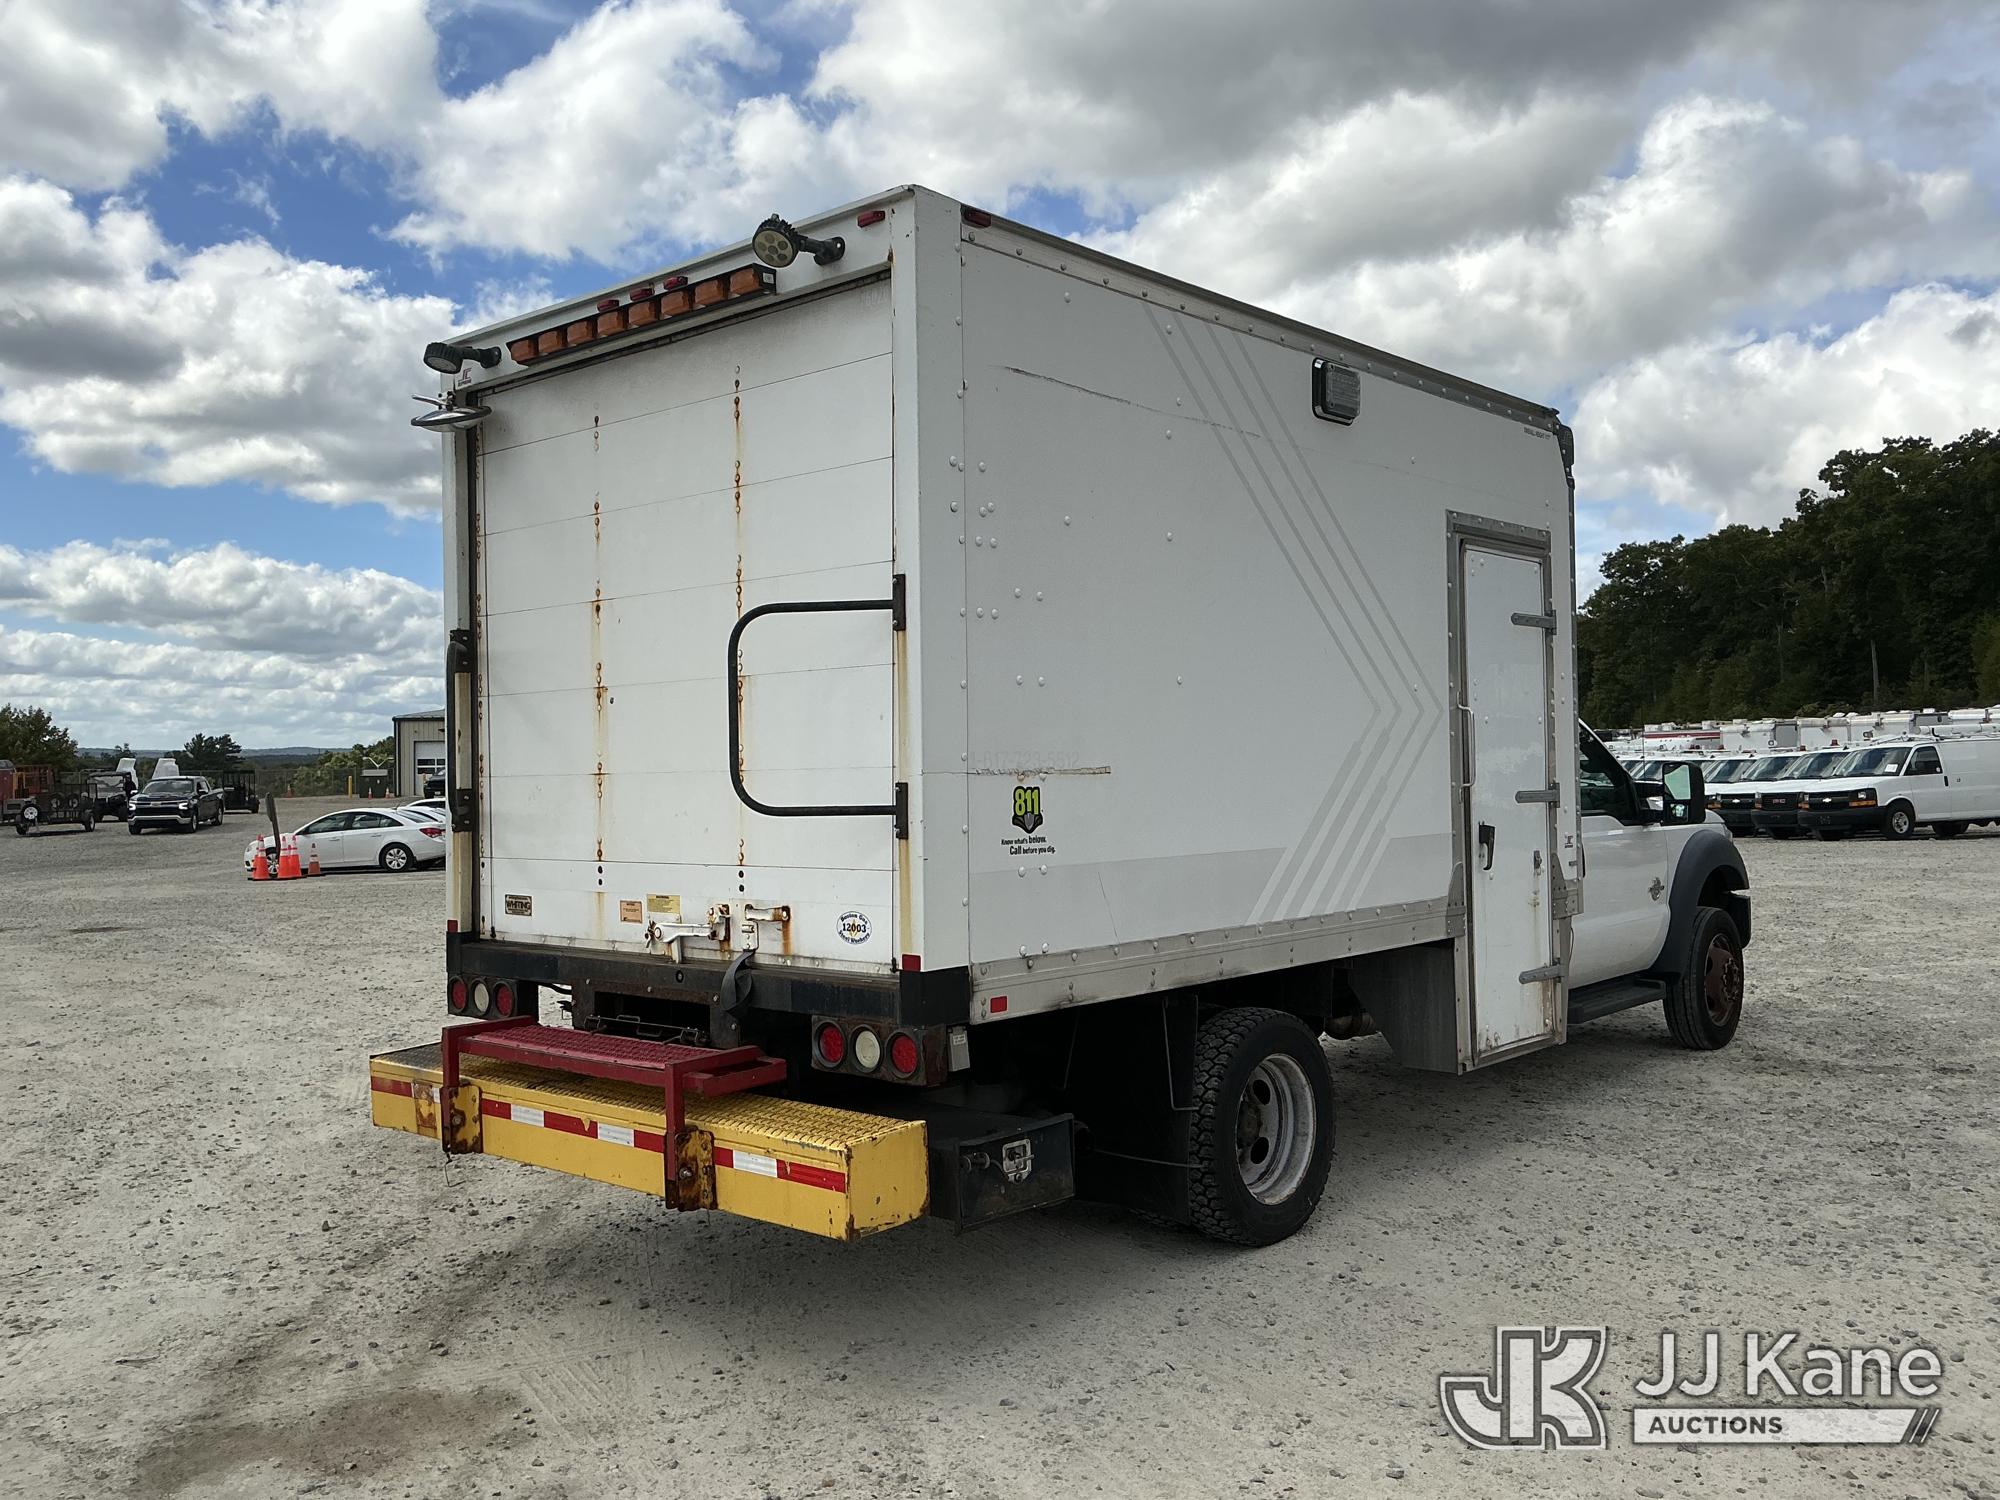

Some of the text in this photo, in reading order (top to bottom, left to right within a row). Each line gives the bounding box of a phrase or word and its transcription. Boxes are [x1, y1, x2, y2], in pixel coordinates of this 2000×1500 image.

[1014, 787, 1039, 816] 811
[1010, 845, 1022, 855] Call
[843, 923, 866, 932] 12003
